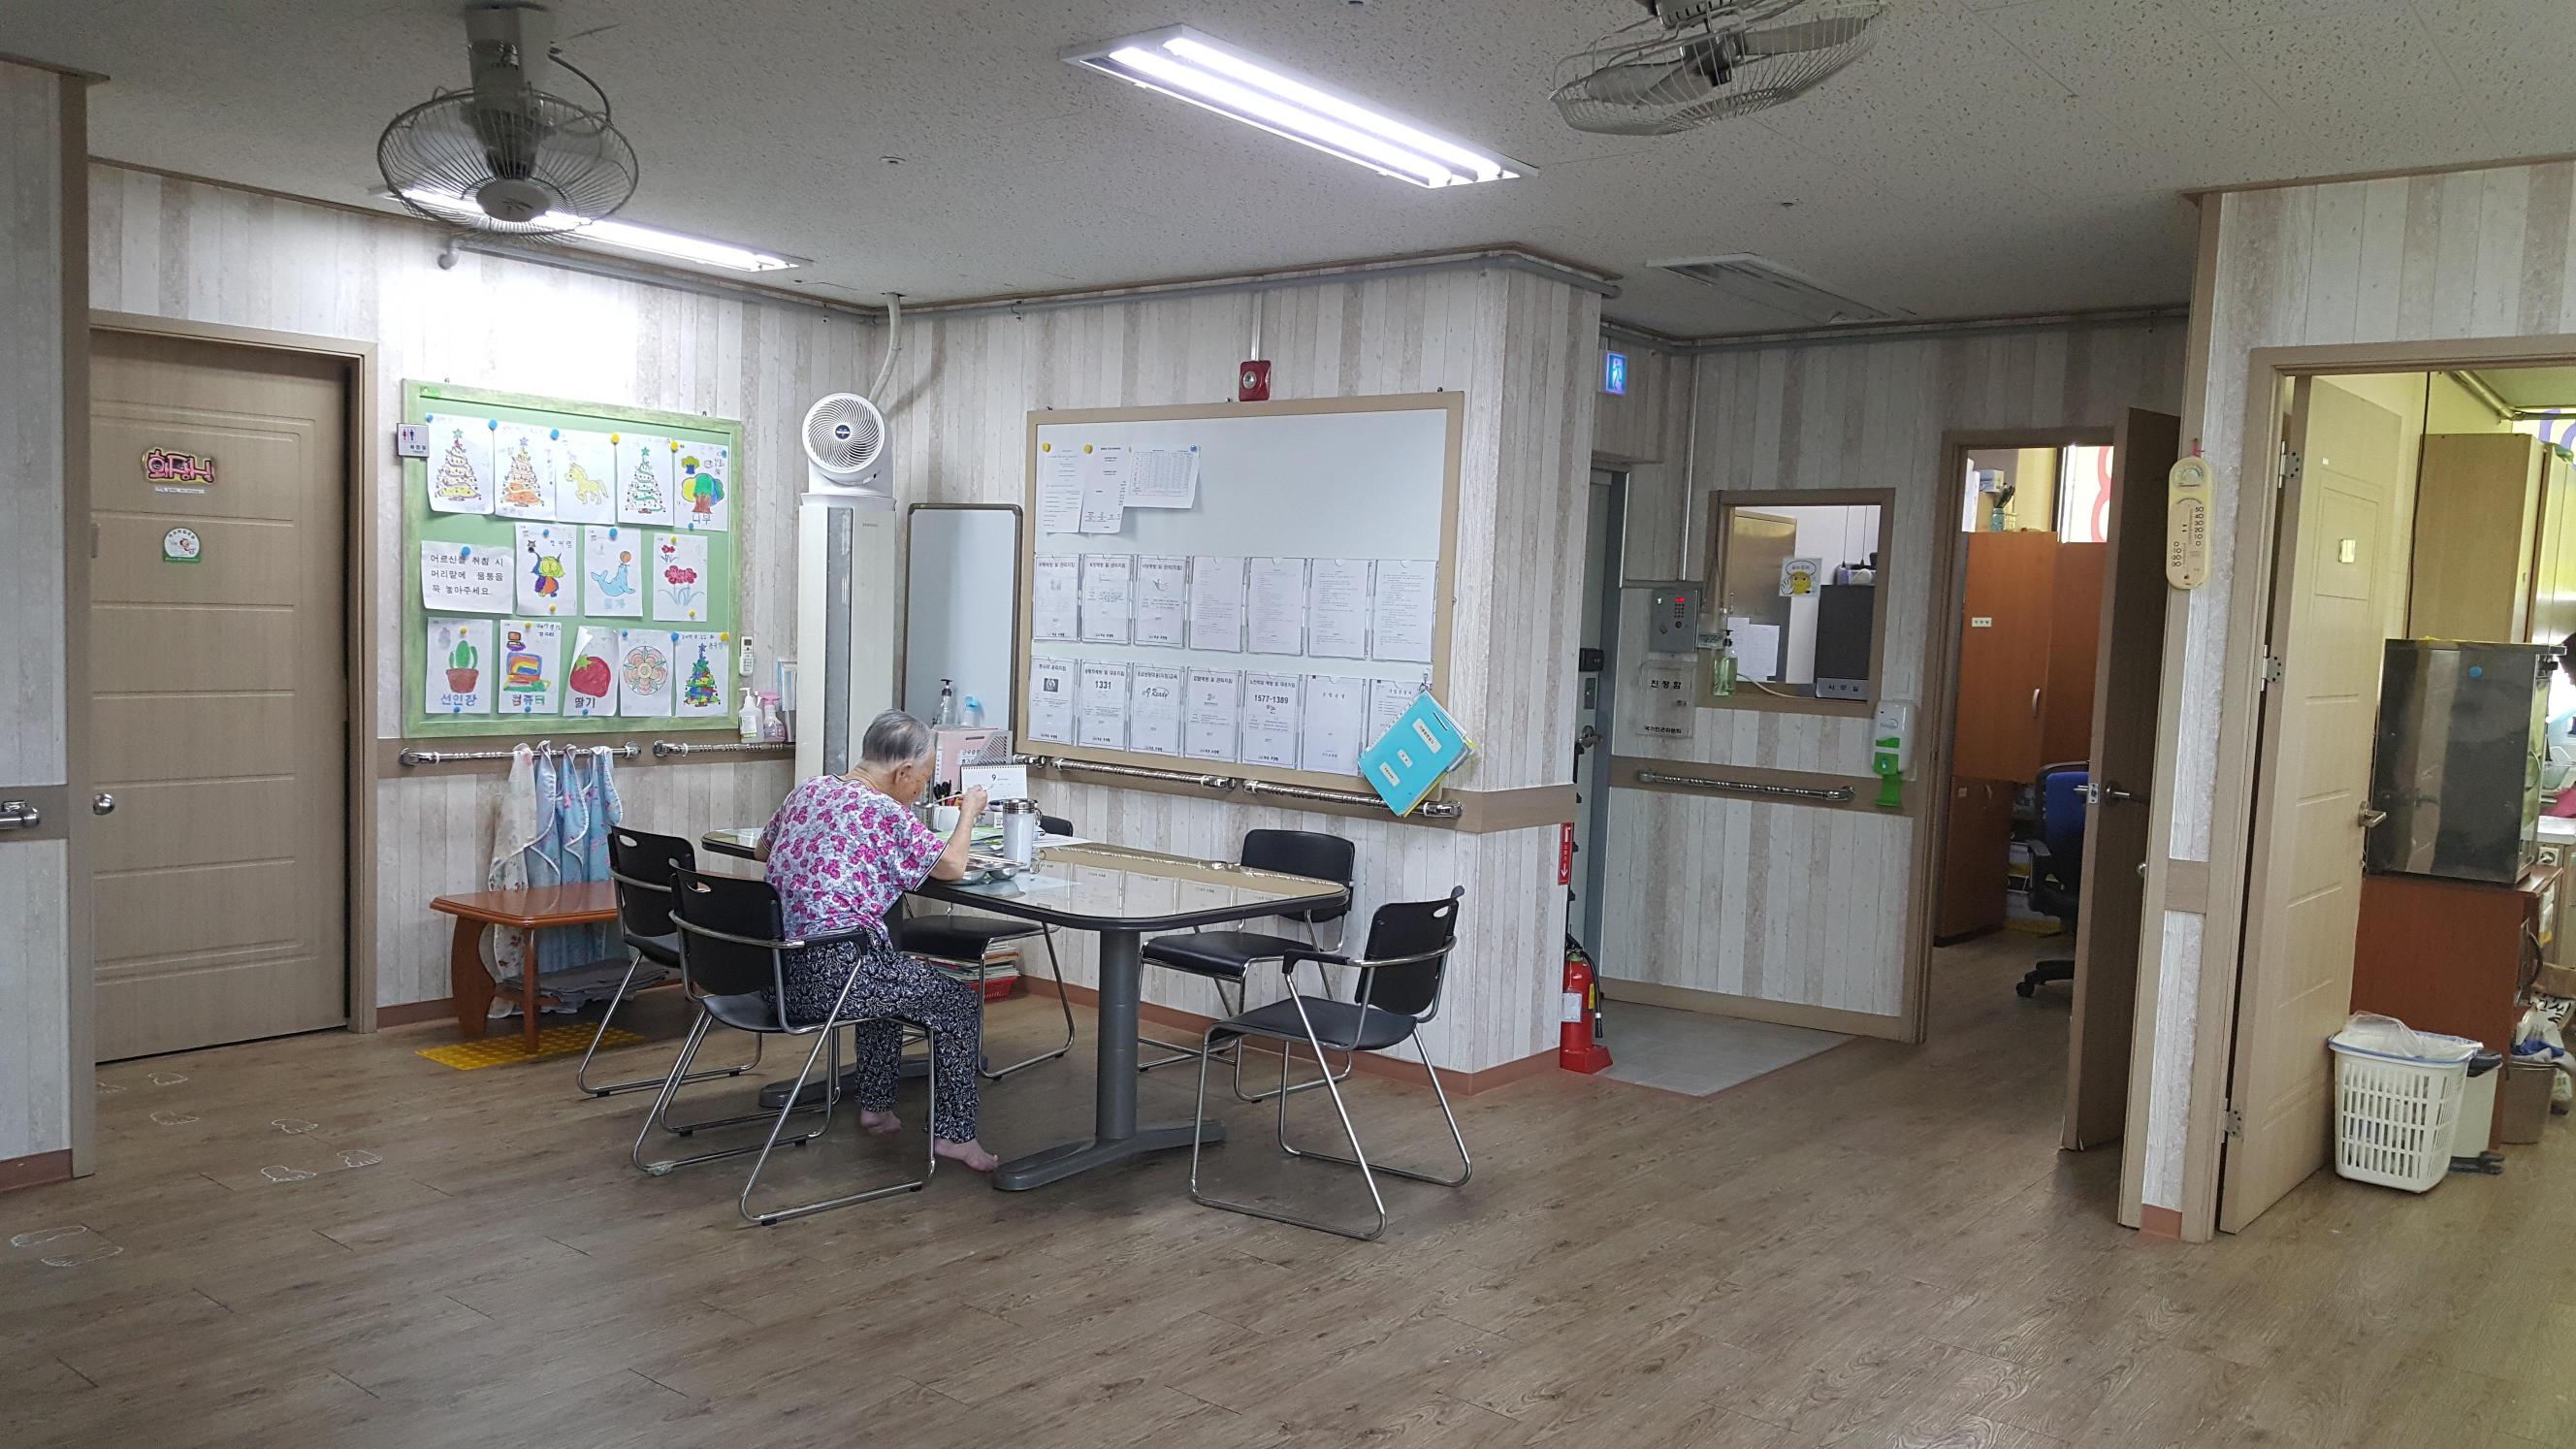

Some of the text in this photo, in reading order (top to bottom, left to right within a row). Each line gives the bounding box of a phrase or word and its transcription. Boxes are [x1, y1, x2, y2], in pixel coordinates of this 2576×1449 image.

[692, 513, 711, 525] 나무
[472, 556, 489, 566] 취침
[495, 558, 503, 566] 시
[432, 584, 440, 594] 꼭
[1095, 680, 1111, 691] 1331
[440, 693, 477, 707] 선인장
[512, 693, 545, 707] 컴퓨터
[574, 696, 596, 708] 딸기
[1254, 694, 1289, 704] 1577-1389
